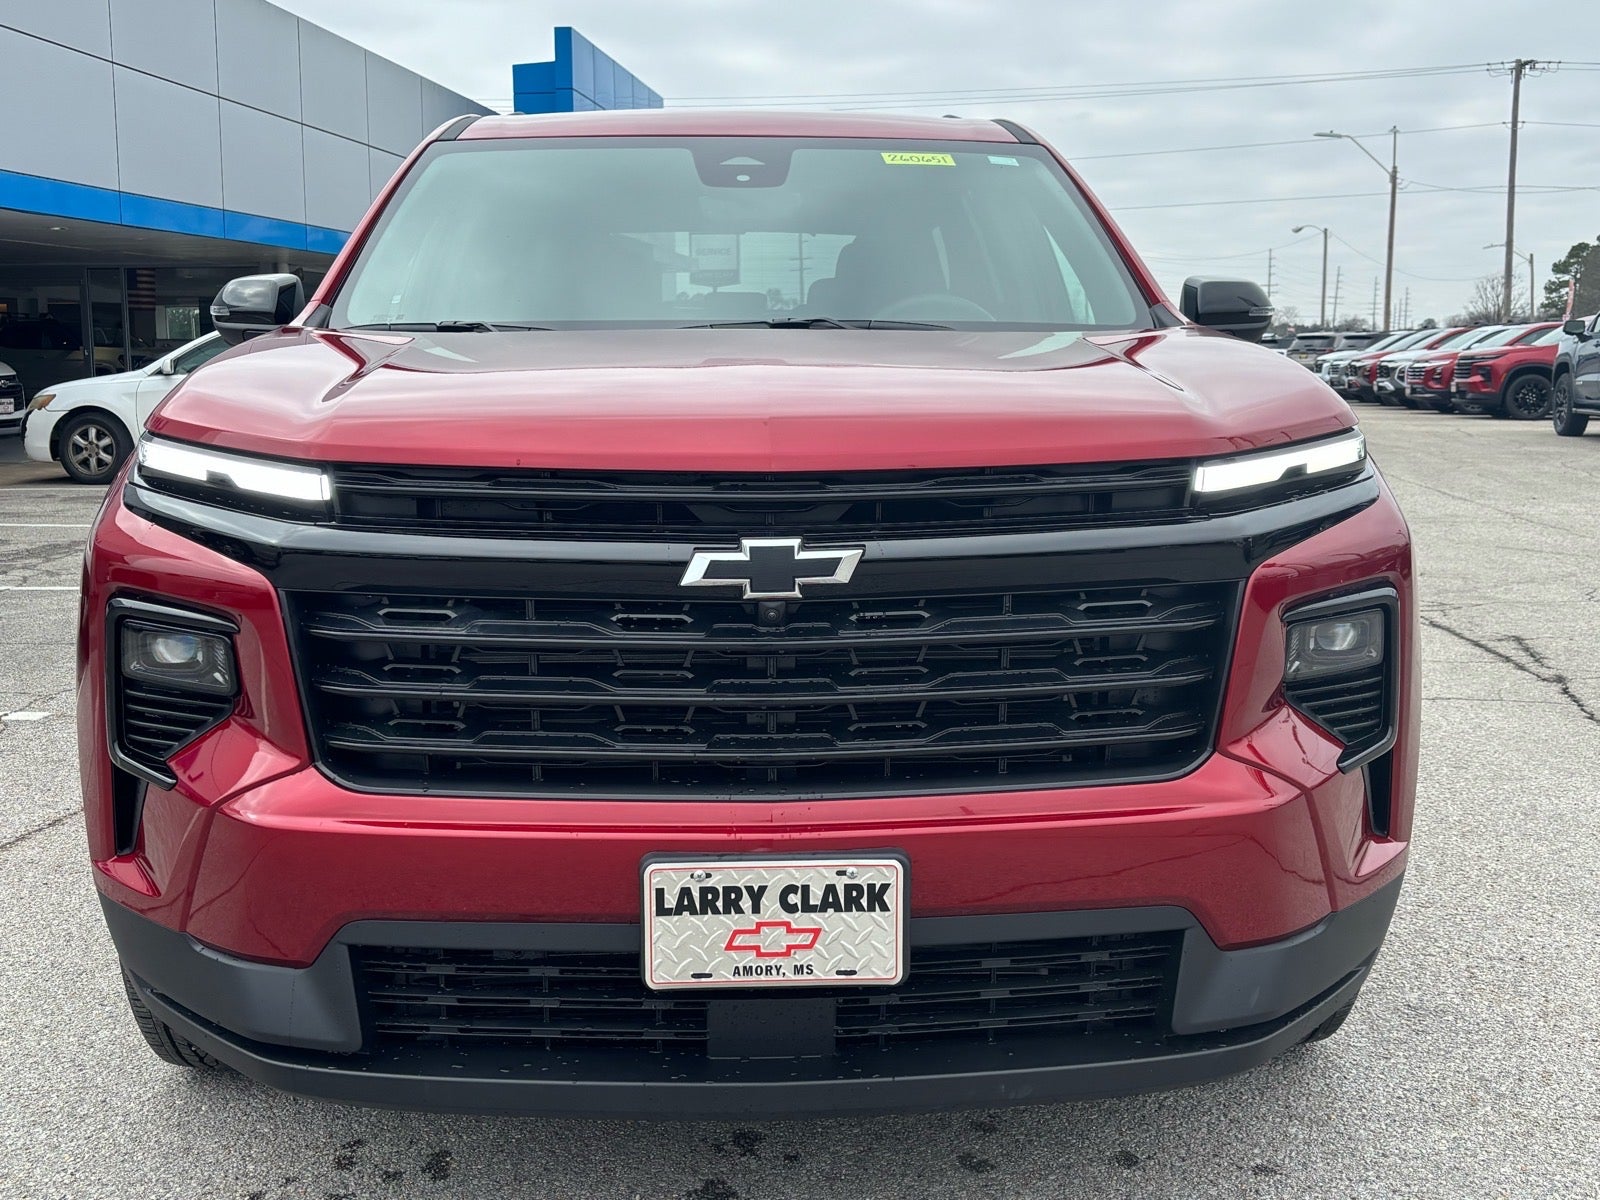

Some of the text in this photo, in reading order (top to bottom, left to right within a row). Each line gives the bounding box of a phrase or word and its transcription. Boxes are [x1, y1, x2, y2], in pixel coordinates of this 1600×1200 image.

[887, 153, 948, 164] 260651
[655, 883, 892, 916] LARRY CLARK
[732, 964, 814, 978] AMORY, MS
